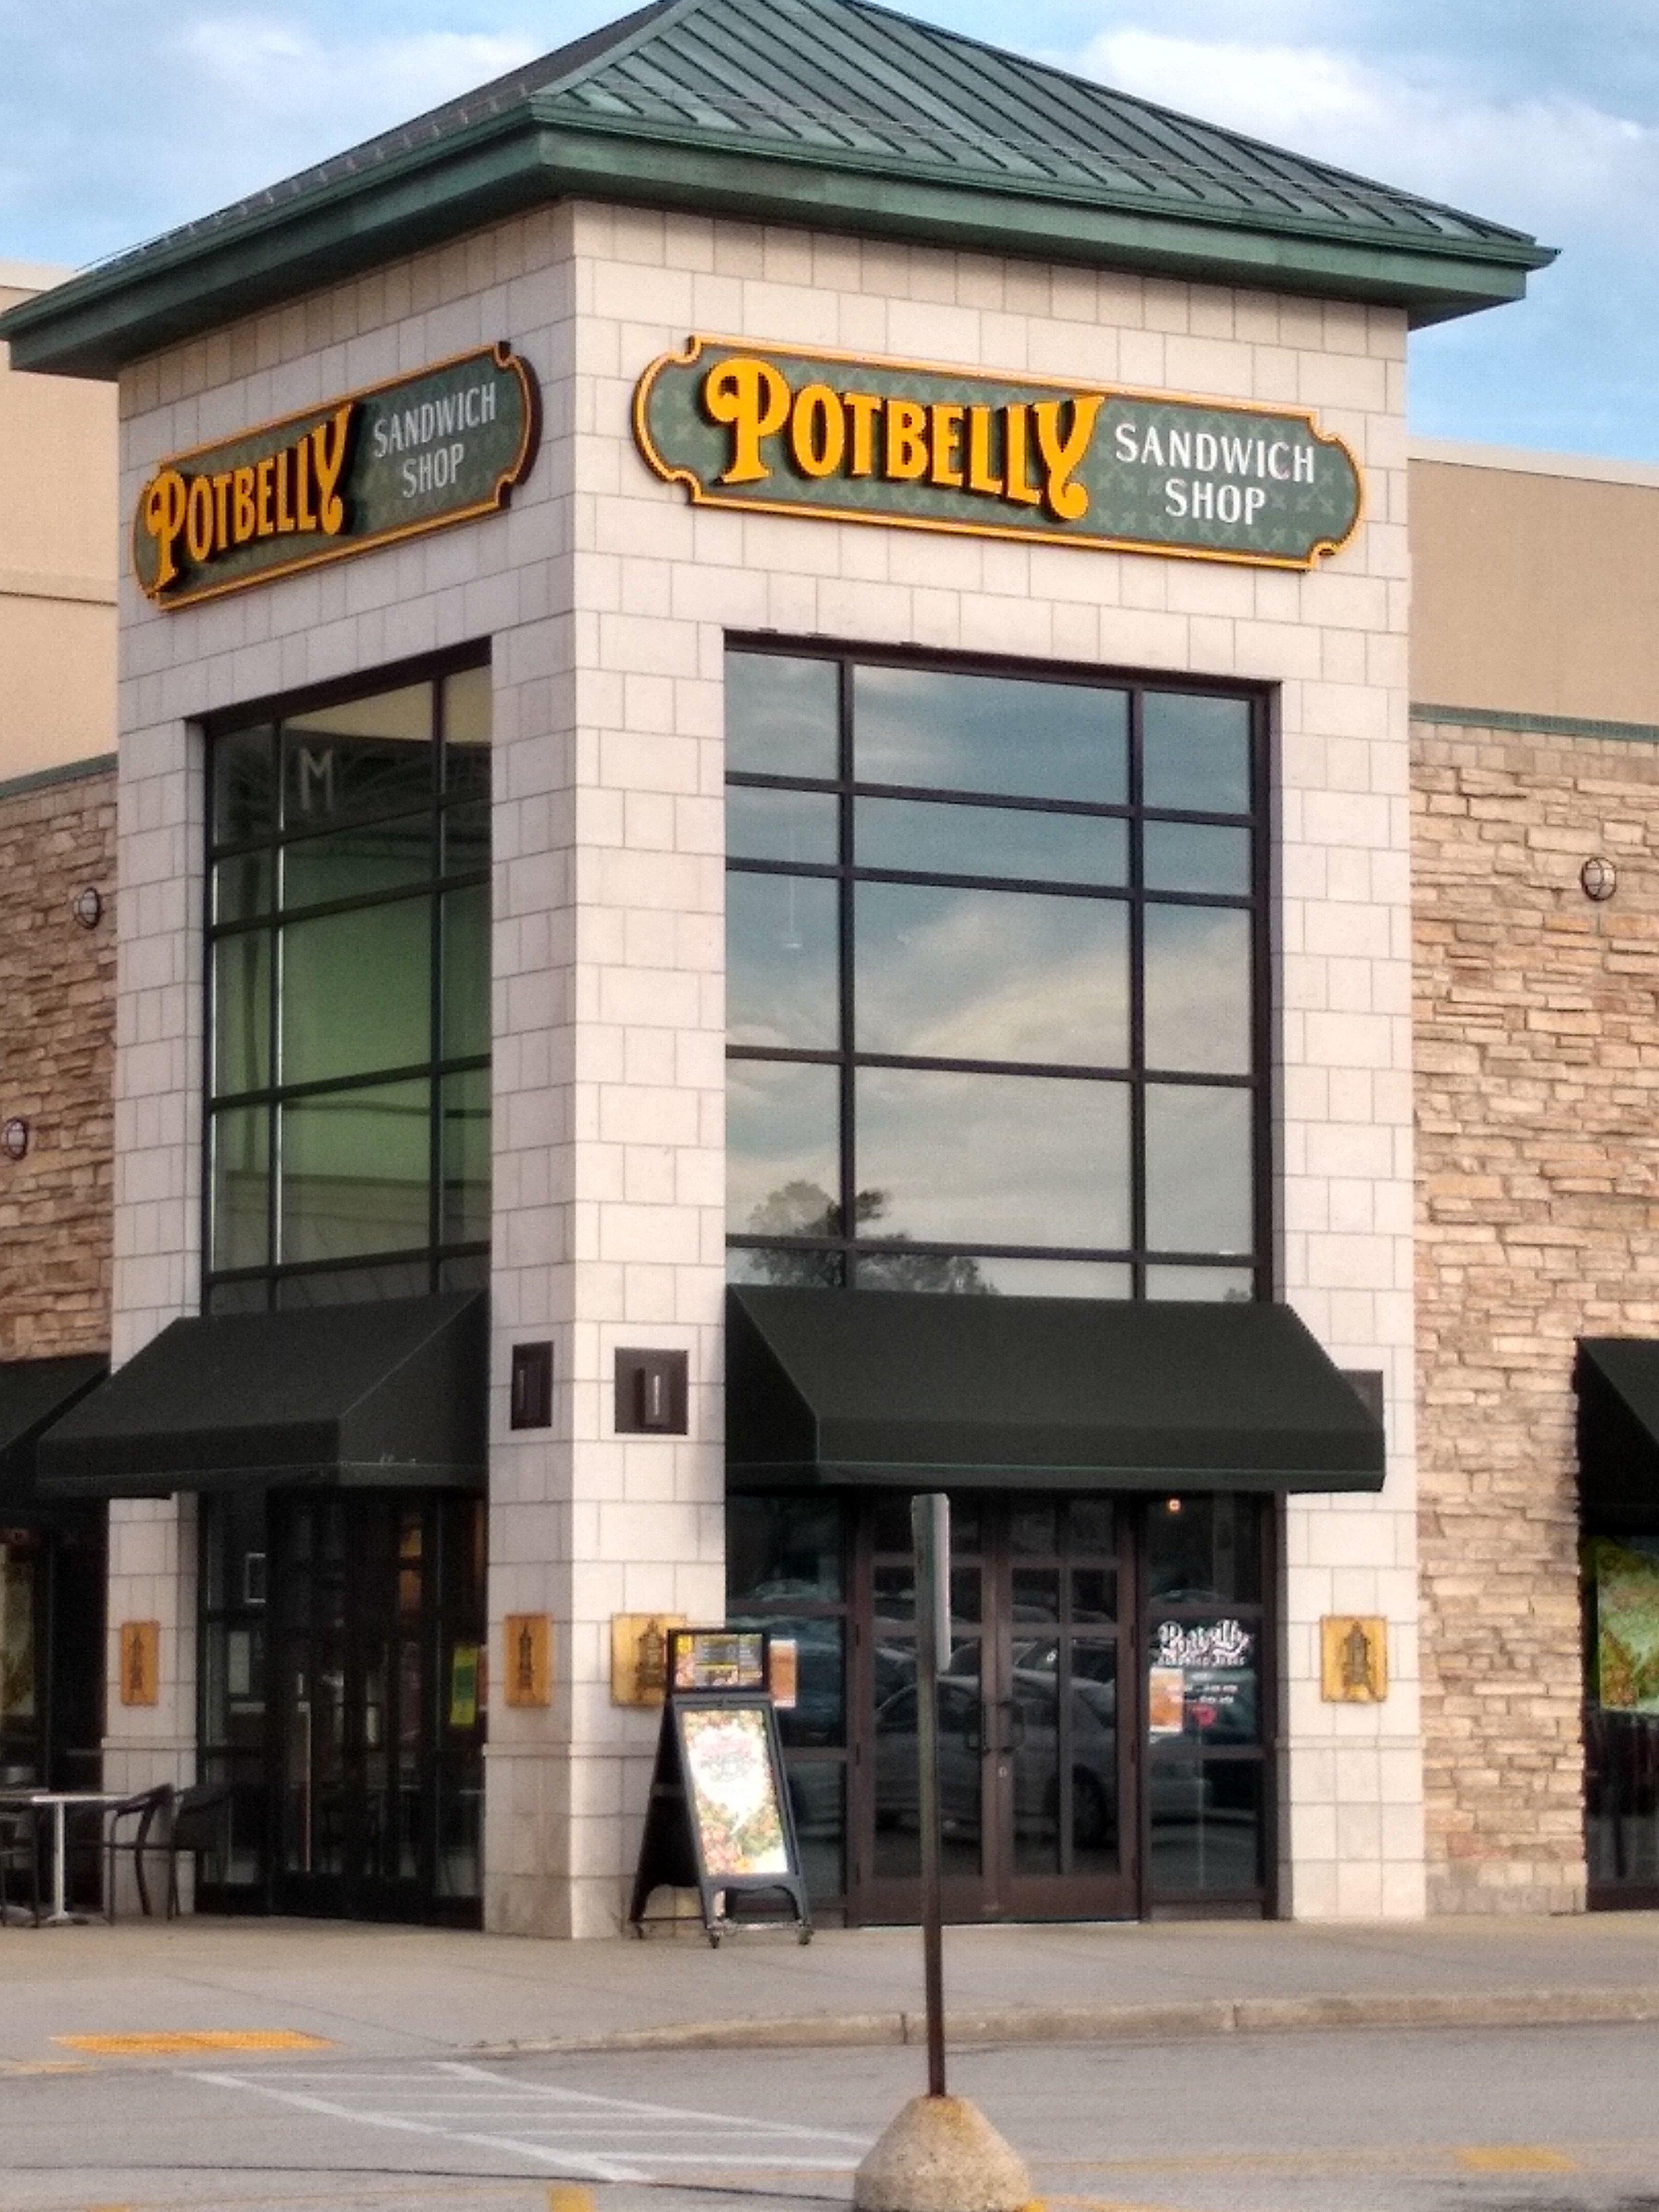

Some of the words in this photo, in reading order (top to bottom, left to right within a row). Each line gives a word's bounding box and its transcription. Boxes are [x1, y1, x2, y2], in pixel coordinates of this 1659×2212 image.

[373, 382, 497, 457] SANDWICH
[704, 357, 1104, 520] POTBELLY
[1115, 423, 1314, 484] SANDWICH
[145, 402, 354, 590] POTBELLY
[401, 443, 464, 499] SHOP
[1164, 478, 1265, 525] SHOP
